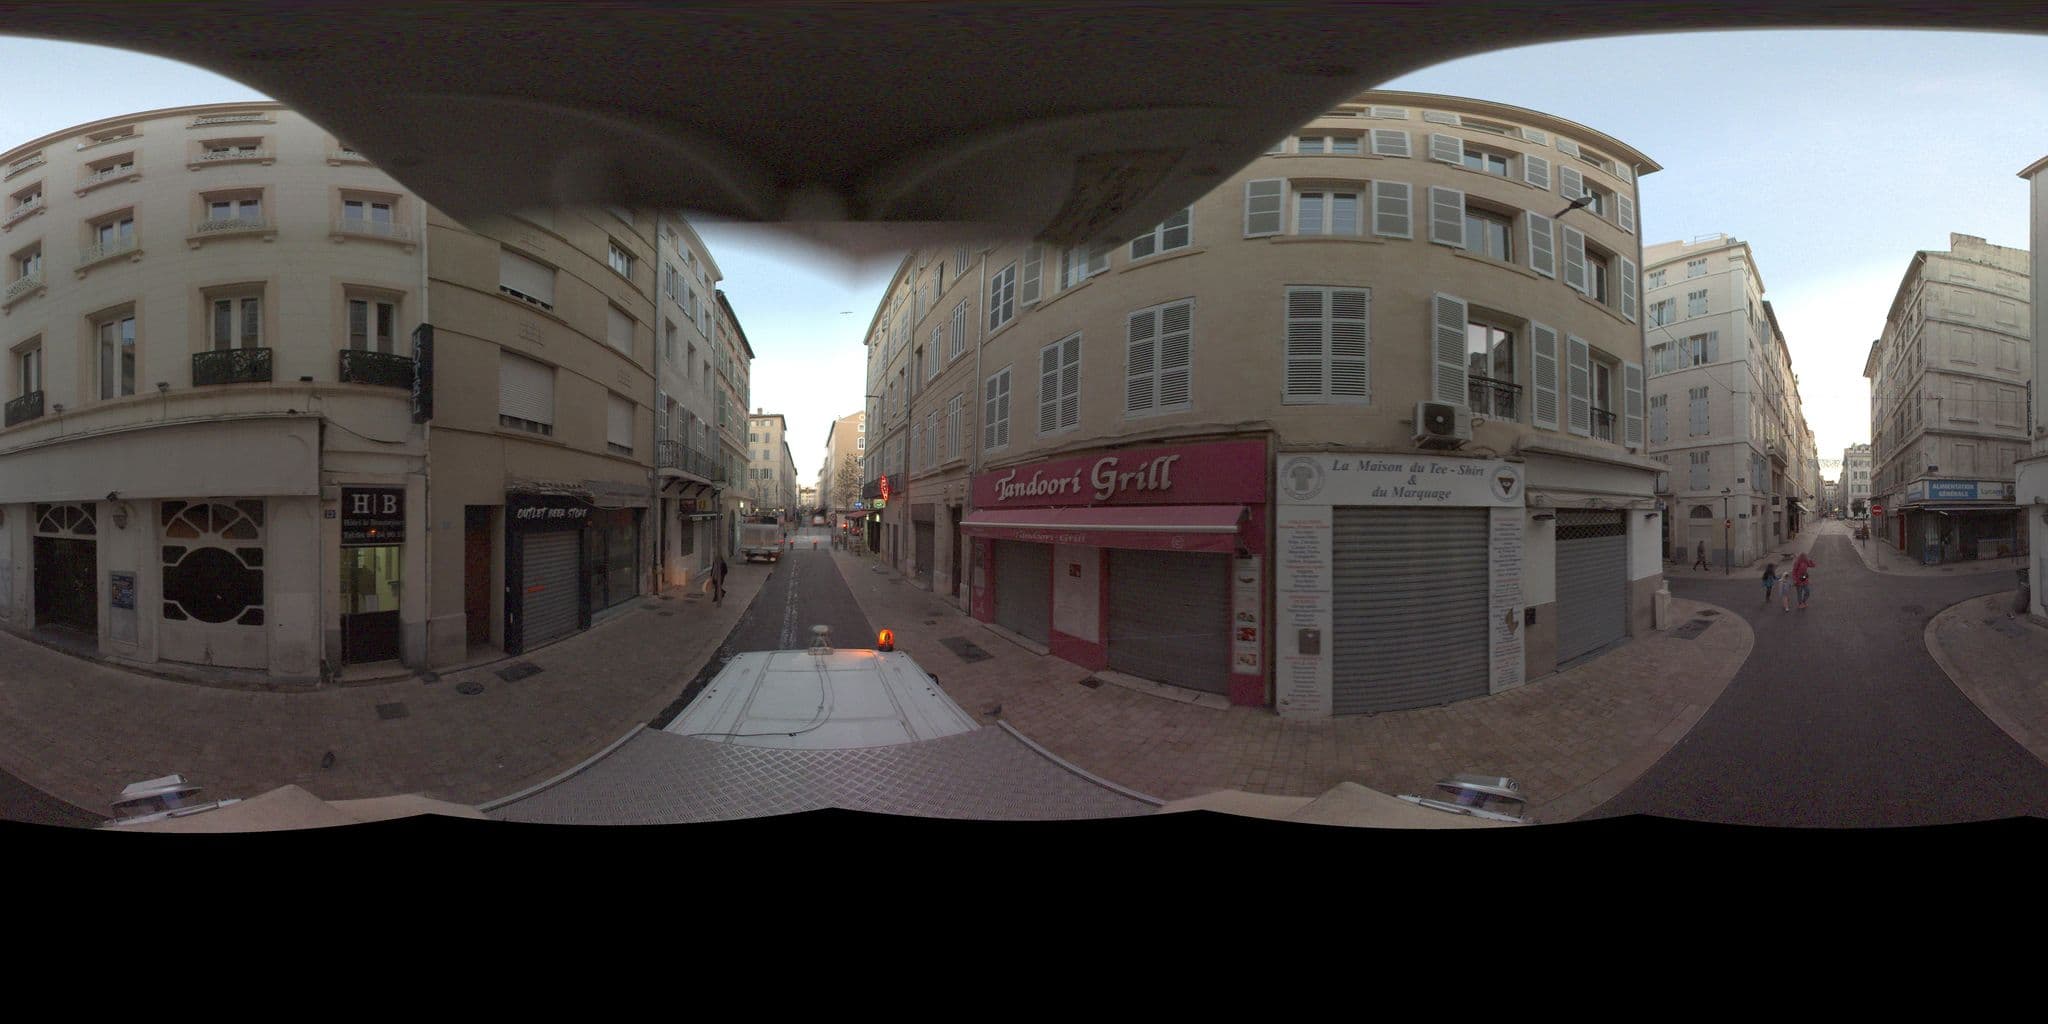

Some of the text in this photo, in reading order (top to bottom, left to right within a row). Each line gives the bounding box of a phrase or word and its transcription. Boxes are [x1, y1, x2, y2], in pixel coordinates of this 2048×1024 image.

[1332, 460, 1349, 471] La
[1357, 460, 1402, 473] Maison
[1409, 461, 1425, 473] du
[995, 455, 1180, 501] Tandoori Grill
[1407, 475, 1417, 485] &
[1371, 487, 1452, 500] du Marquage
[517, 507, 547, 519] OUTLET
